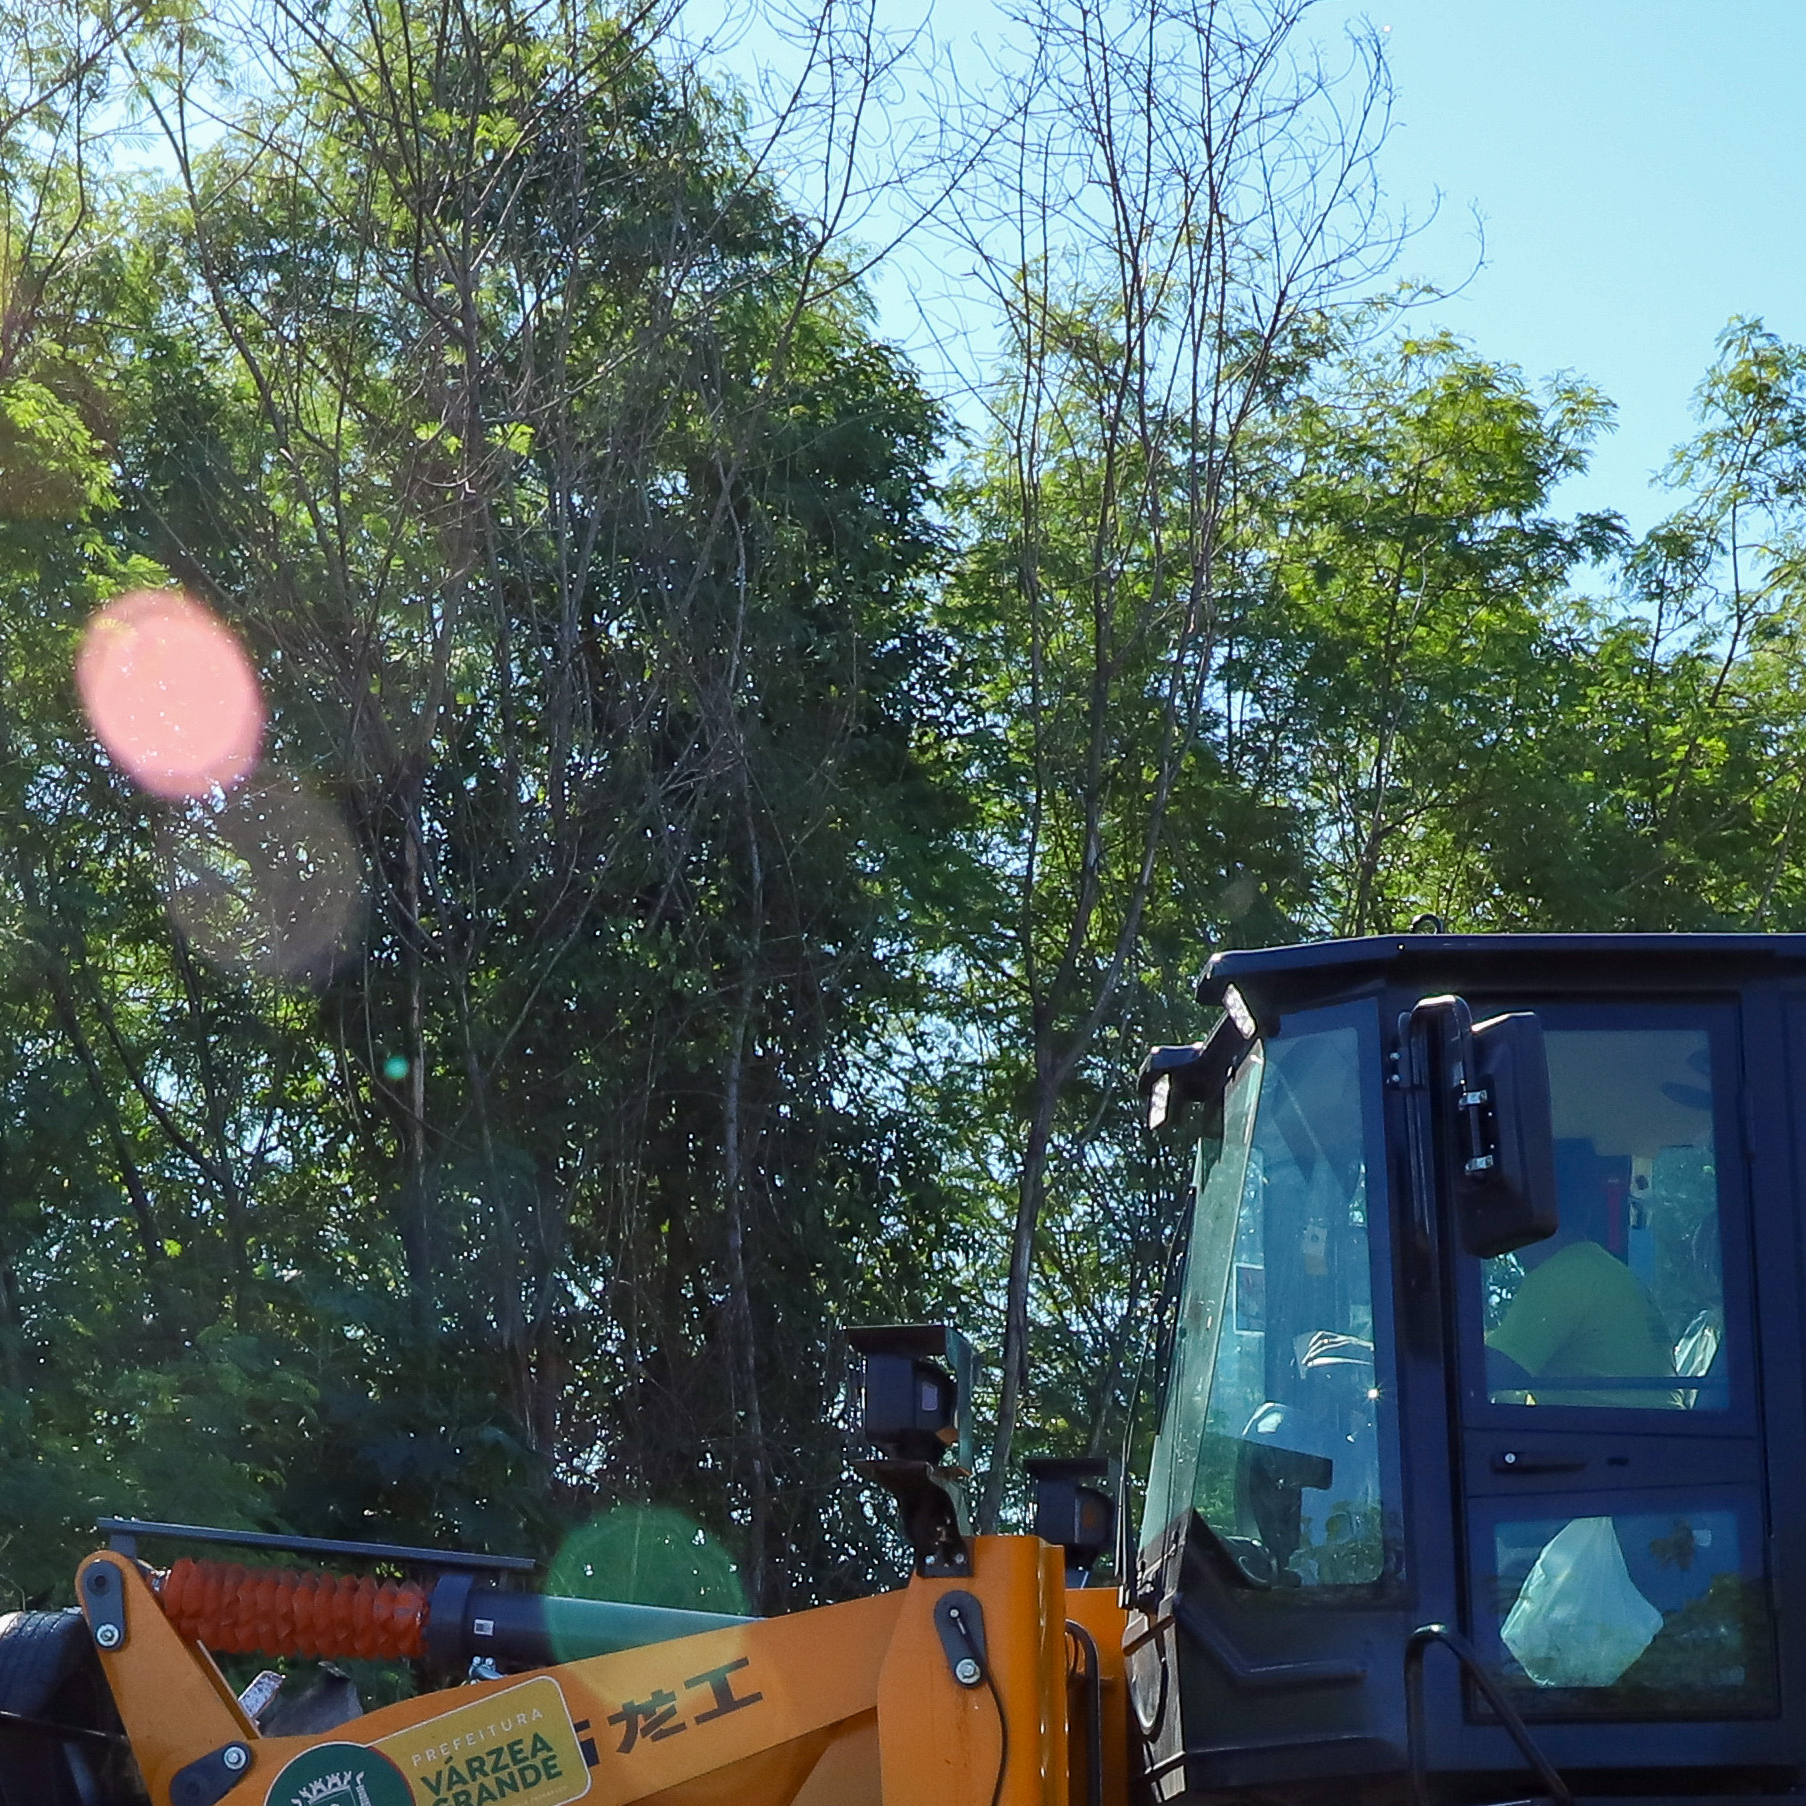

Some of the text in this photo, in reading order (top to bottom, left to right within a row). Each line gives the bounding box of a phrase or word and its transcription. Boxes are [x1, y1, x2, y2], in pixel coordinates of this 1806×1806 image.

[411, 1707, 544, 1768] PREFEITURA
[607, 1656, 764, 1755] 龙工
[419, 1731, 554, 1797] VÁRZEA
